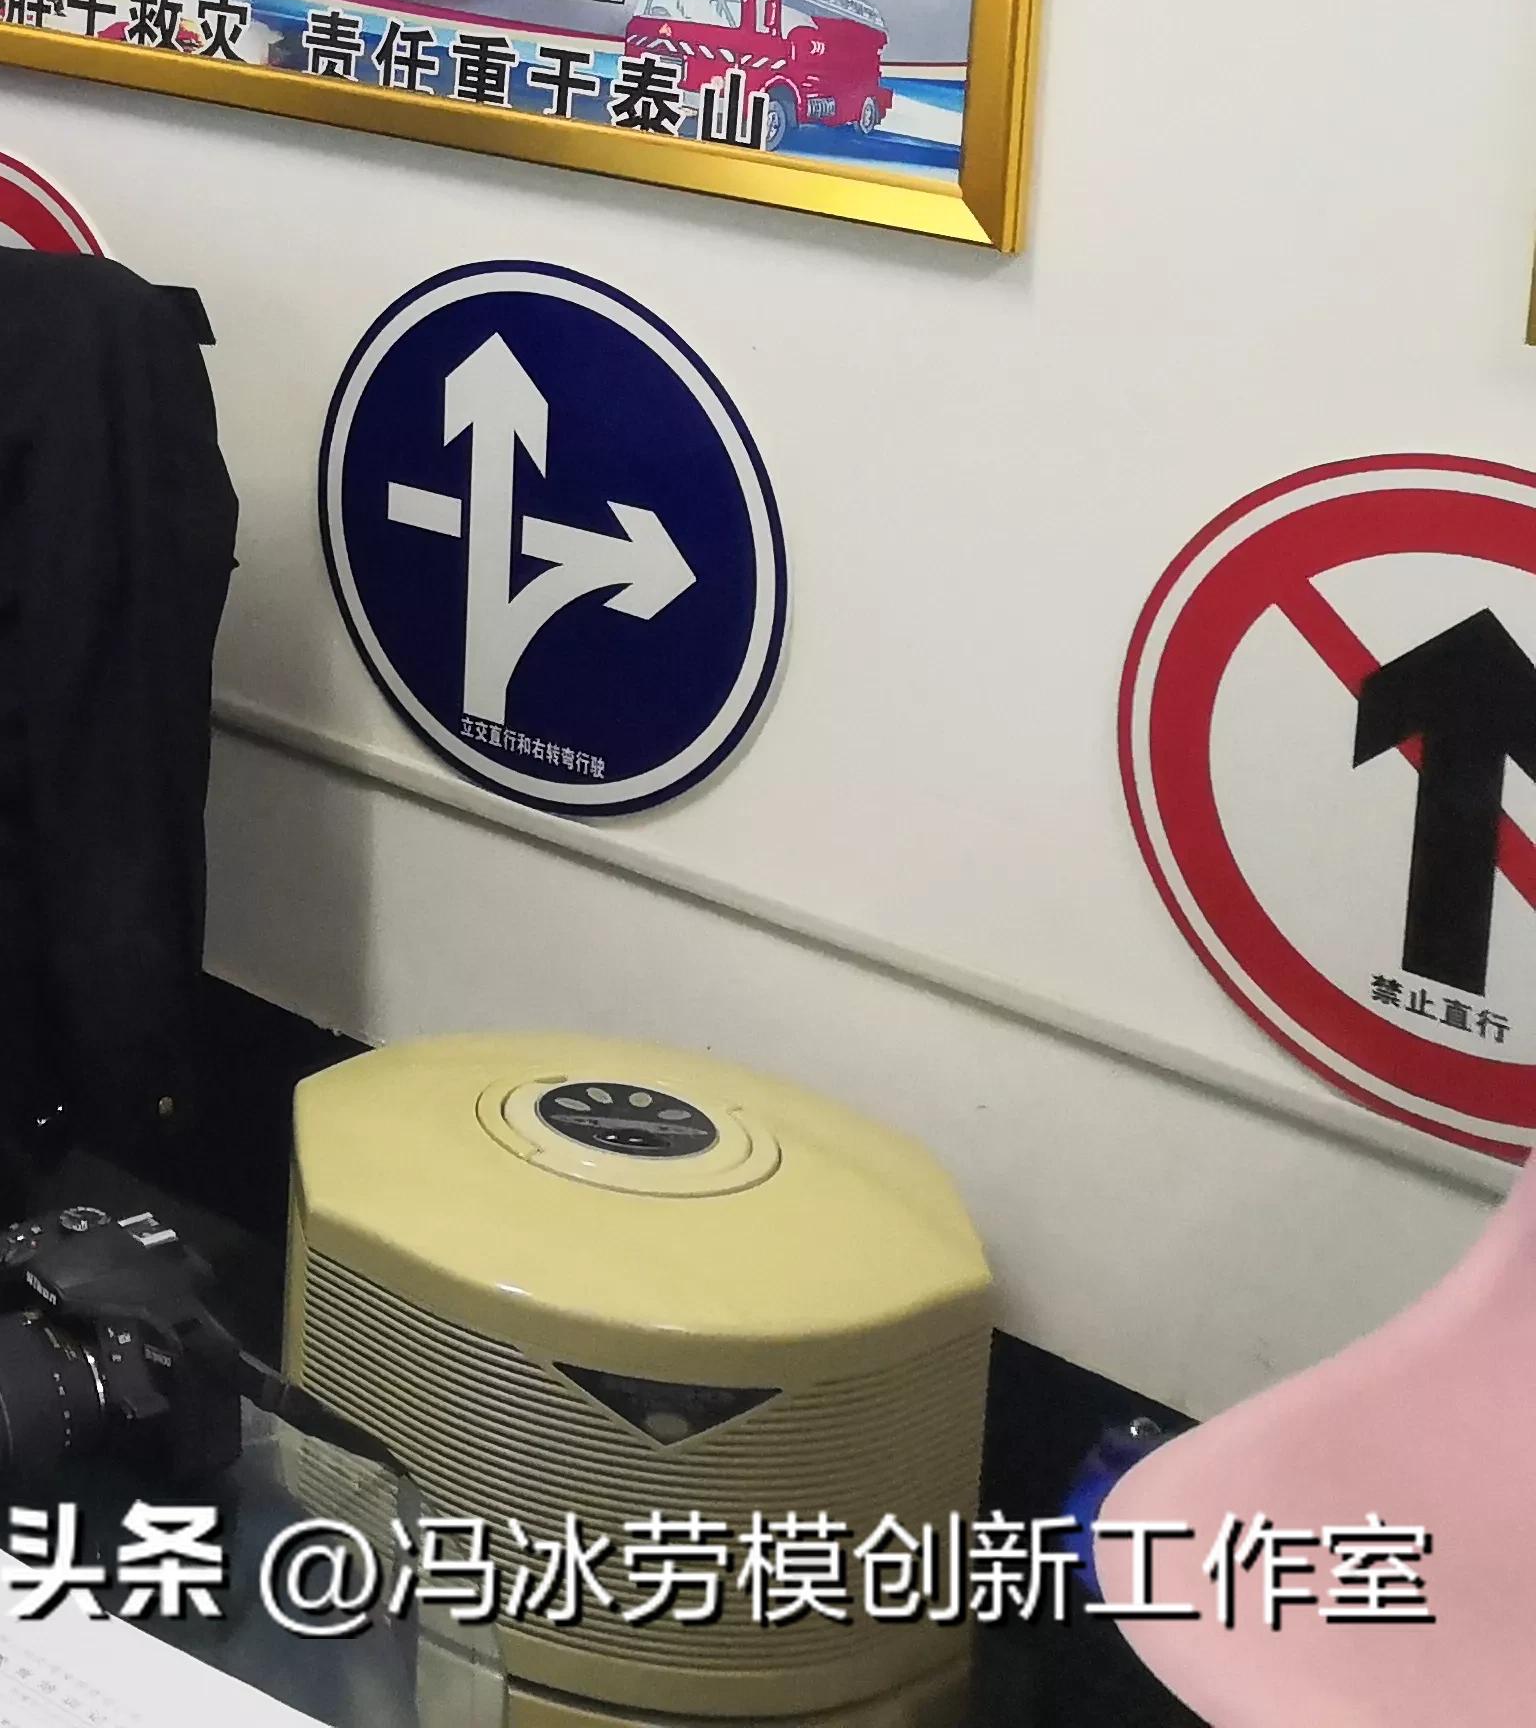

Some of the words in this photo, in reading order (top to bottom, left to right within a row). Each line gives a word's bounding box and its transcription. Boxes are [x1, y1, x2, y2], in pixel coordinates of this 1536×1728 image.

[302, 10, 769, 151] 责任重于泰山
[460, 716, 605, 781] 立交直行和右转弯行驶
[1370, 973, 1510, 1045] 禁止直行
